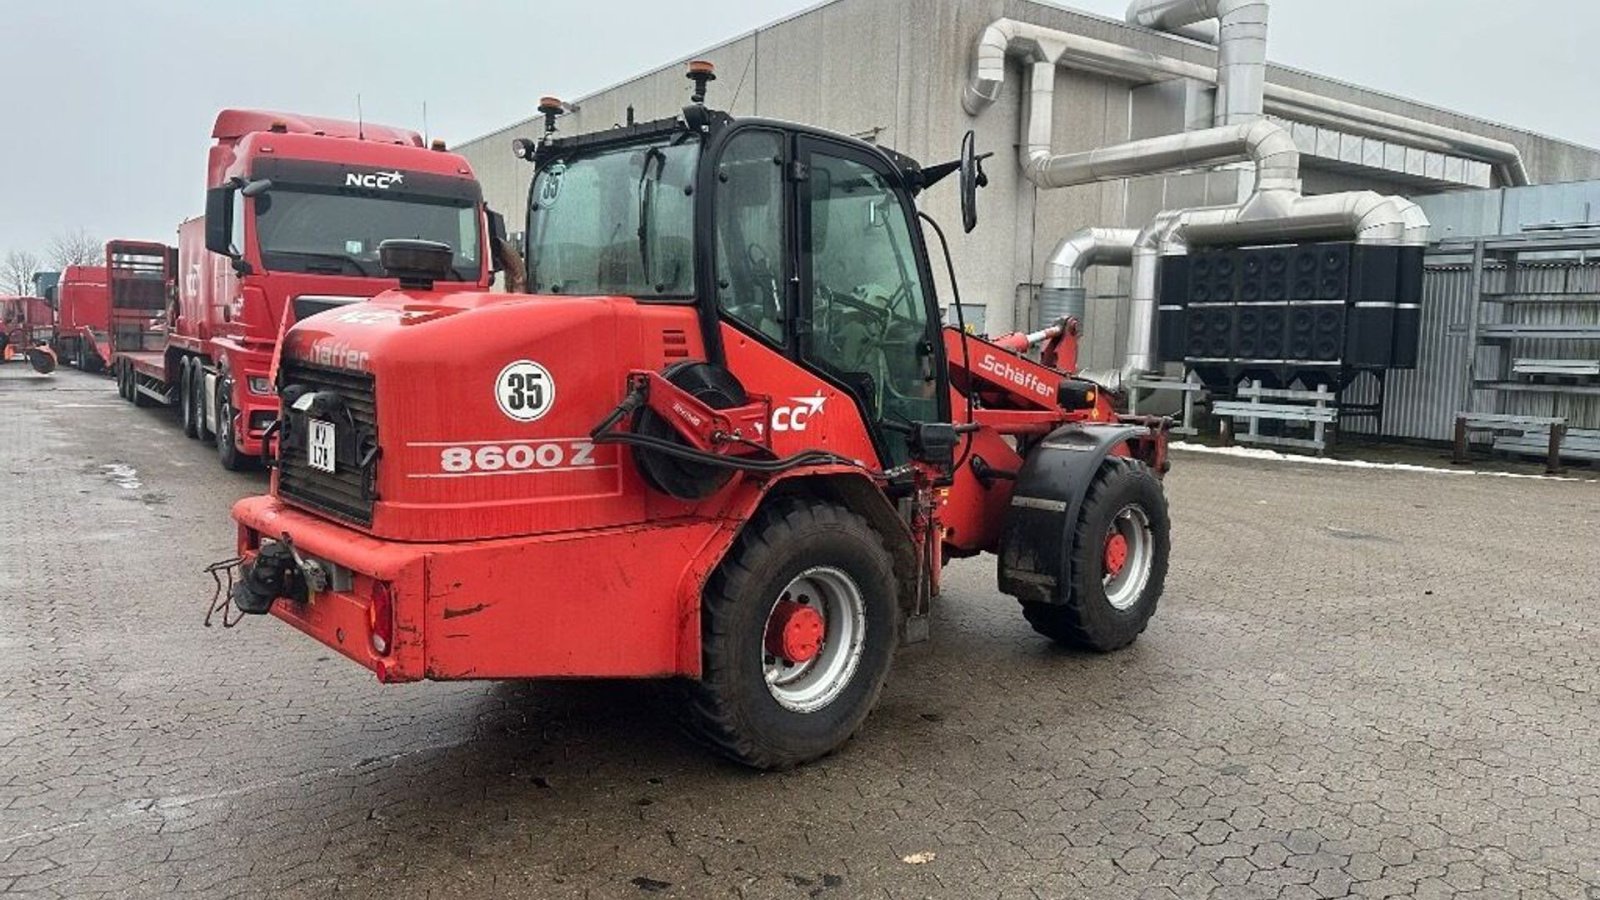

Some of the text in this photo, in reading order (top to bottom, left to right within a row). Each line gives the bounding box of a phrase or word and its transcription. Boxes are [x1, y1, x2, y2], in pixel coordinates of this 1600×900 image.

[345, 173, 390, 189] NCC
[507, 373, 544, 411] 35
[978, 354, 1054, 397] Schäffer
[440, 442, 595, 472] 8600 Z
